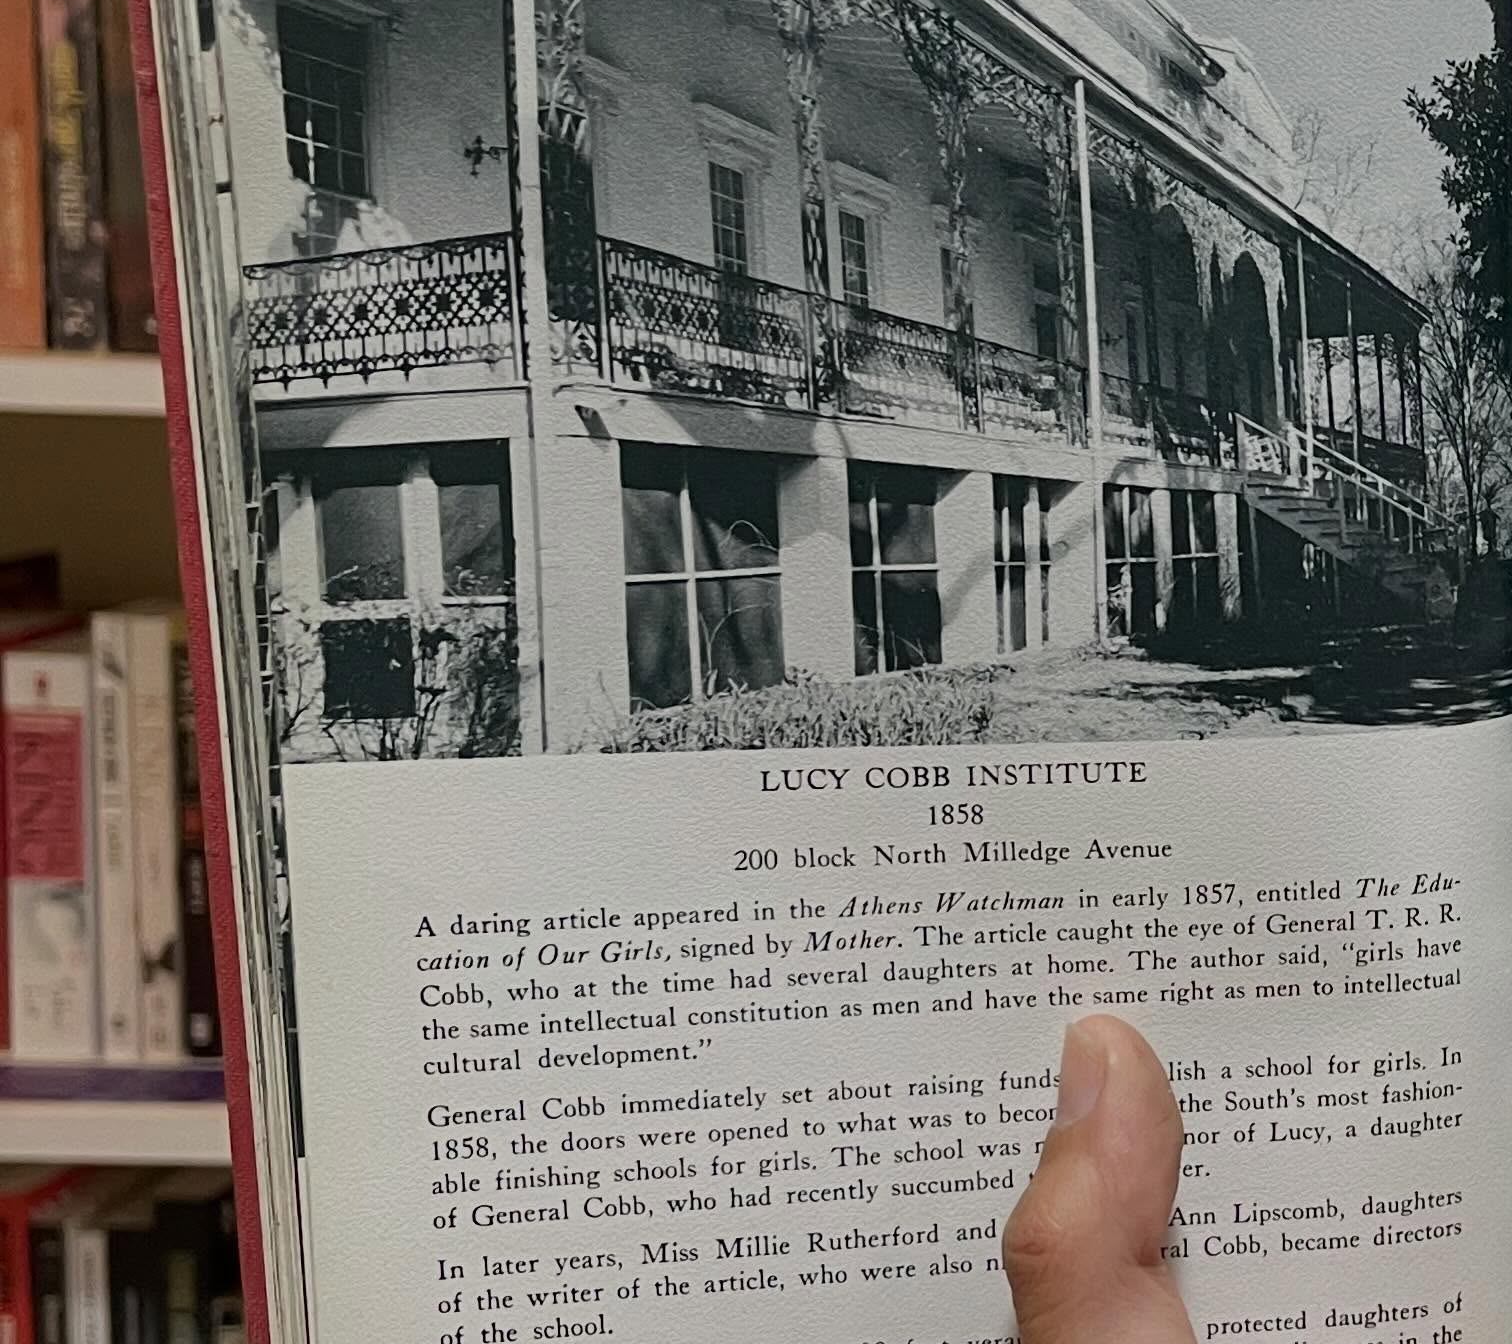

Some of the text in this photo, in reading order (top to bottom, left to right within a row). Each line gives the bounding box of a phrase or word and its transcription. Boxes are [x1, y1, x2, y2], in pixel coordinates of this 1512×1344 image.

[759, 761, 1148, 792] LUCY COBB INSTITUTE
[928, 802, 984, 826] 1858
[733, 838, 1173, 872] 200 block North Milledge Avenue
[413, 871, 1461, 938] A daring article appeared in the Athens Watchman in early 1857, entitled The Edu-
[419, 982, 493, 1009] Cobb,
[506, 978, 559, 1002] who
[573, 981, 597, 998] at
[611, 973, 649, 997] the
[662, 971, 715, 994] time
[729, 967, 773, 990] had
[786, 961, 869, 987] several
[883, 957, 998, 985] daughters
[1011, 960, 1033, 976] at
[1047, 953, 1115, 975] home.
[1127, 949, 1177, 971] The
[1190, 946, 1266, 969] author
[1278, 943, 1328, 969] said,
[1416, 937, 1462, 959] have
[423, 1048, 522, 1076] cultural
[427, 1099, 527, 1128] General
[542, 1095, 606, 1120] Cobb
[621, 1085, 768, 1115] immediately
[781, 1087, 813, 1105] set
[827, 1079, 893, 1102] about
[908, 1073, 984, 1098] raising
[1220, 1065, 1233, 1080] a
[1245, 1055, 1313, 1079] school
[1327, 1054, 1361, 1075] for
[1373, 1050, 1427, 1078] girls.
[1440, 1046, 1462, 1067] In
[437, 1190, 1463, 1281] In later years, Miss Millie Rutherford and Ann Lipscomb, daughters
